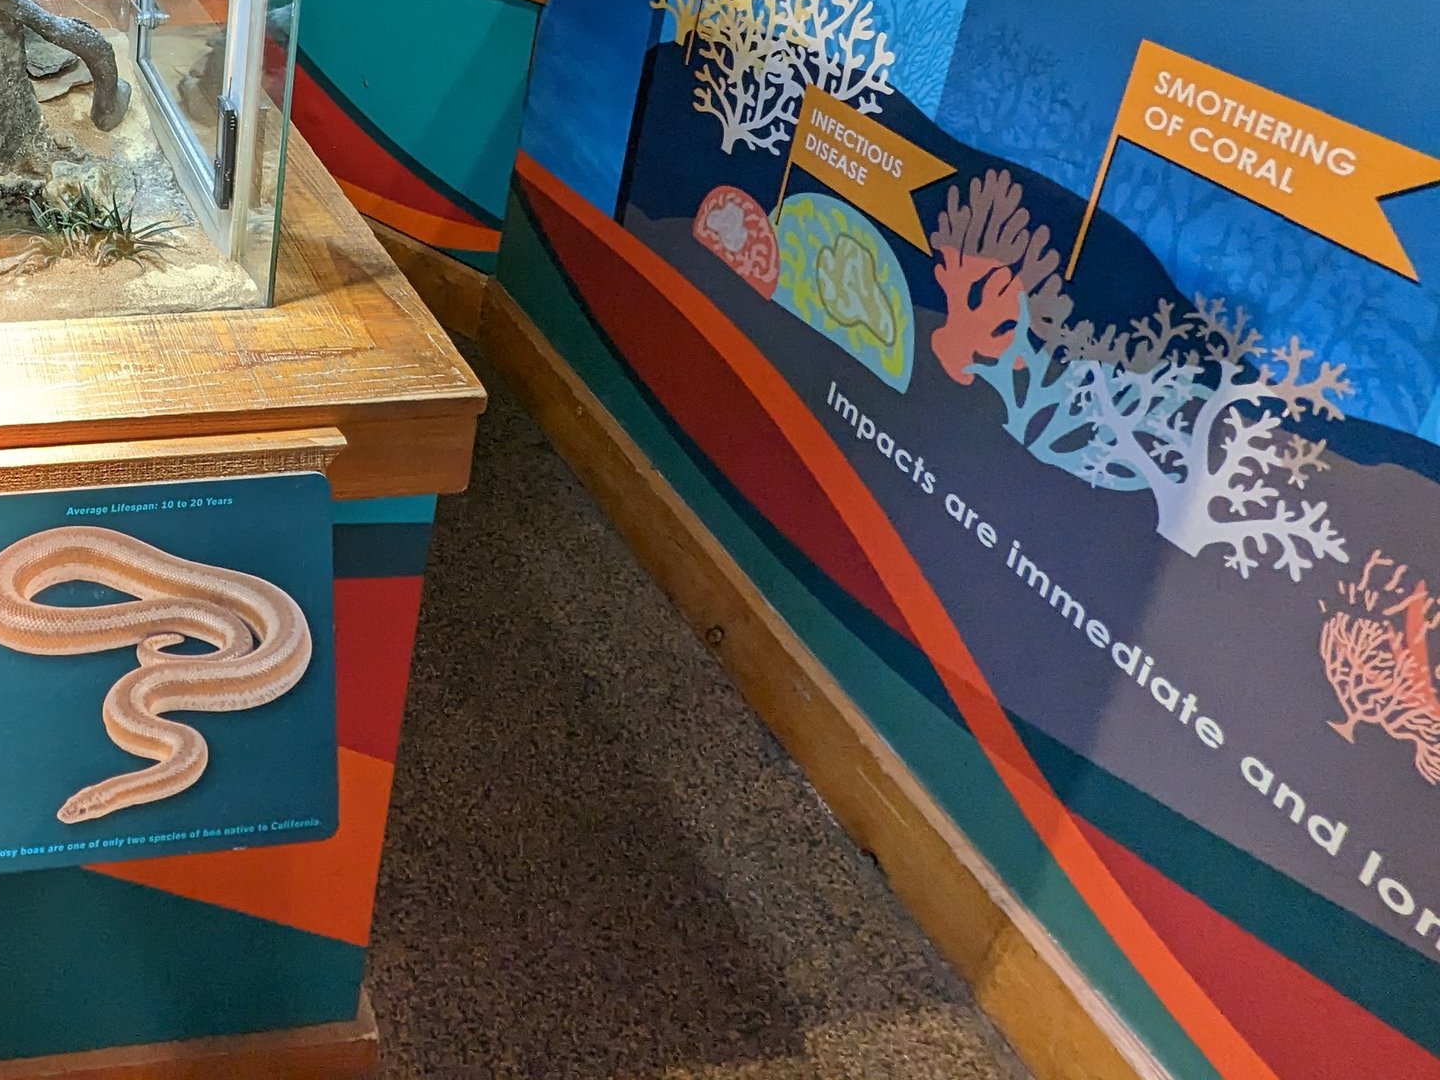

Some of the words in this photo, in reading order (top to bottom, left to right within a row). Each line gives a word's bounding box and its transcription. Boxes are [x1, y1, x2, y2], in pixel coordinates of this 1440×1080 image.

[805, 133, 868, 186] DISEASE
[811, 108, 903, 179] INFECTIOUS
[1144, 105, 1193, 144] OF
[1188, 123, 1294, 195] CORAL
[1153, 70, 1358, 178] SMOTHERING
[66, 505, 108, 517] Average
[111, 502, 159, 515] Lifespan:
[161, 500, 174, 510] 10
[177, 500, 187, 509] to
[190, 498, 203, 508] 20
[206, 497, 233, 507] Years
[826, 379, 938, 496] Impacts
[945, 490, 998, 550] are
[1005, 539, 1225, 750] immediate
[1241, 755, 1349, 857] and
[20, 845, 44, 856] boas
[47, 844, 64, 853] are
[67, 842, 85, 851] one
[88, 840, 100, 849] of
[102, 837, 124, 848] only
[127, 835, 146, 845] two
[149, 831, 187, 844] species
[189, 829, 201, 839] of
[203, 827, 221, 837] boa
[224, 824, 255, 836] native
[258, 823, 268, 832] to
